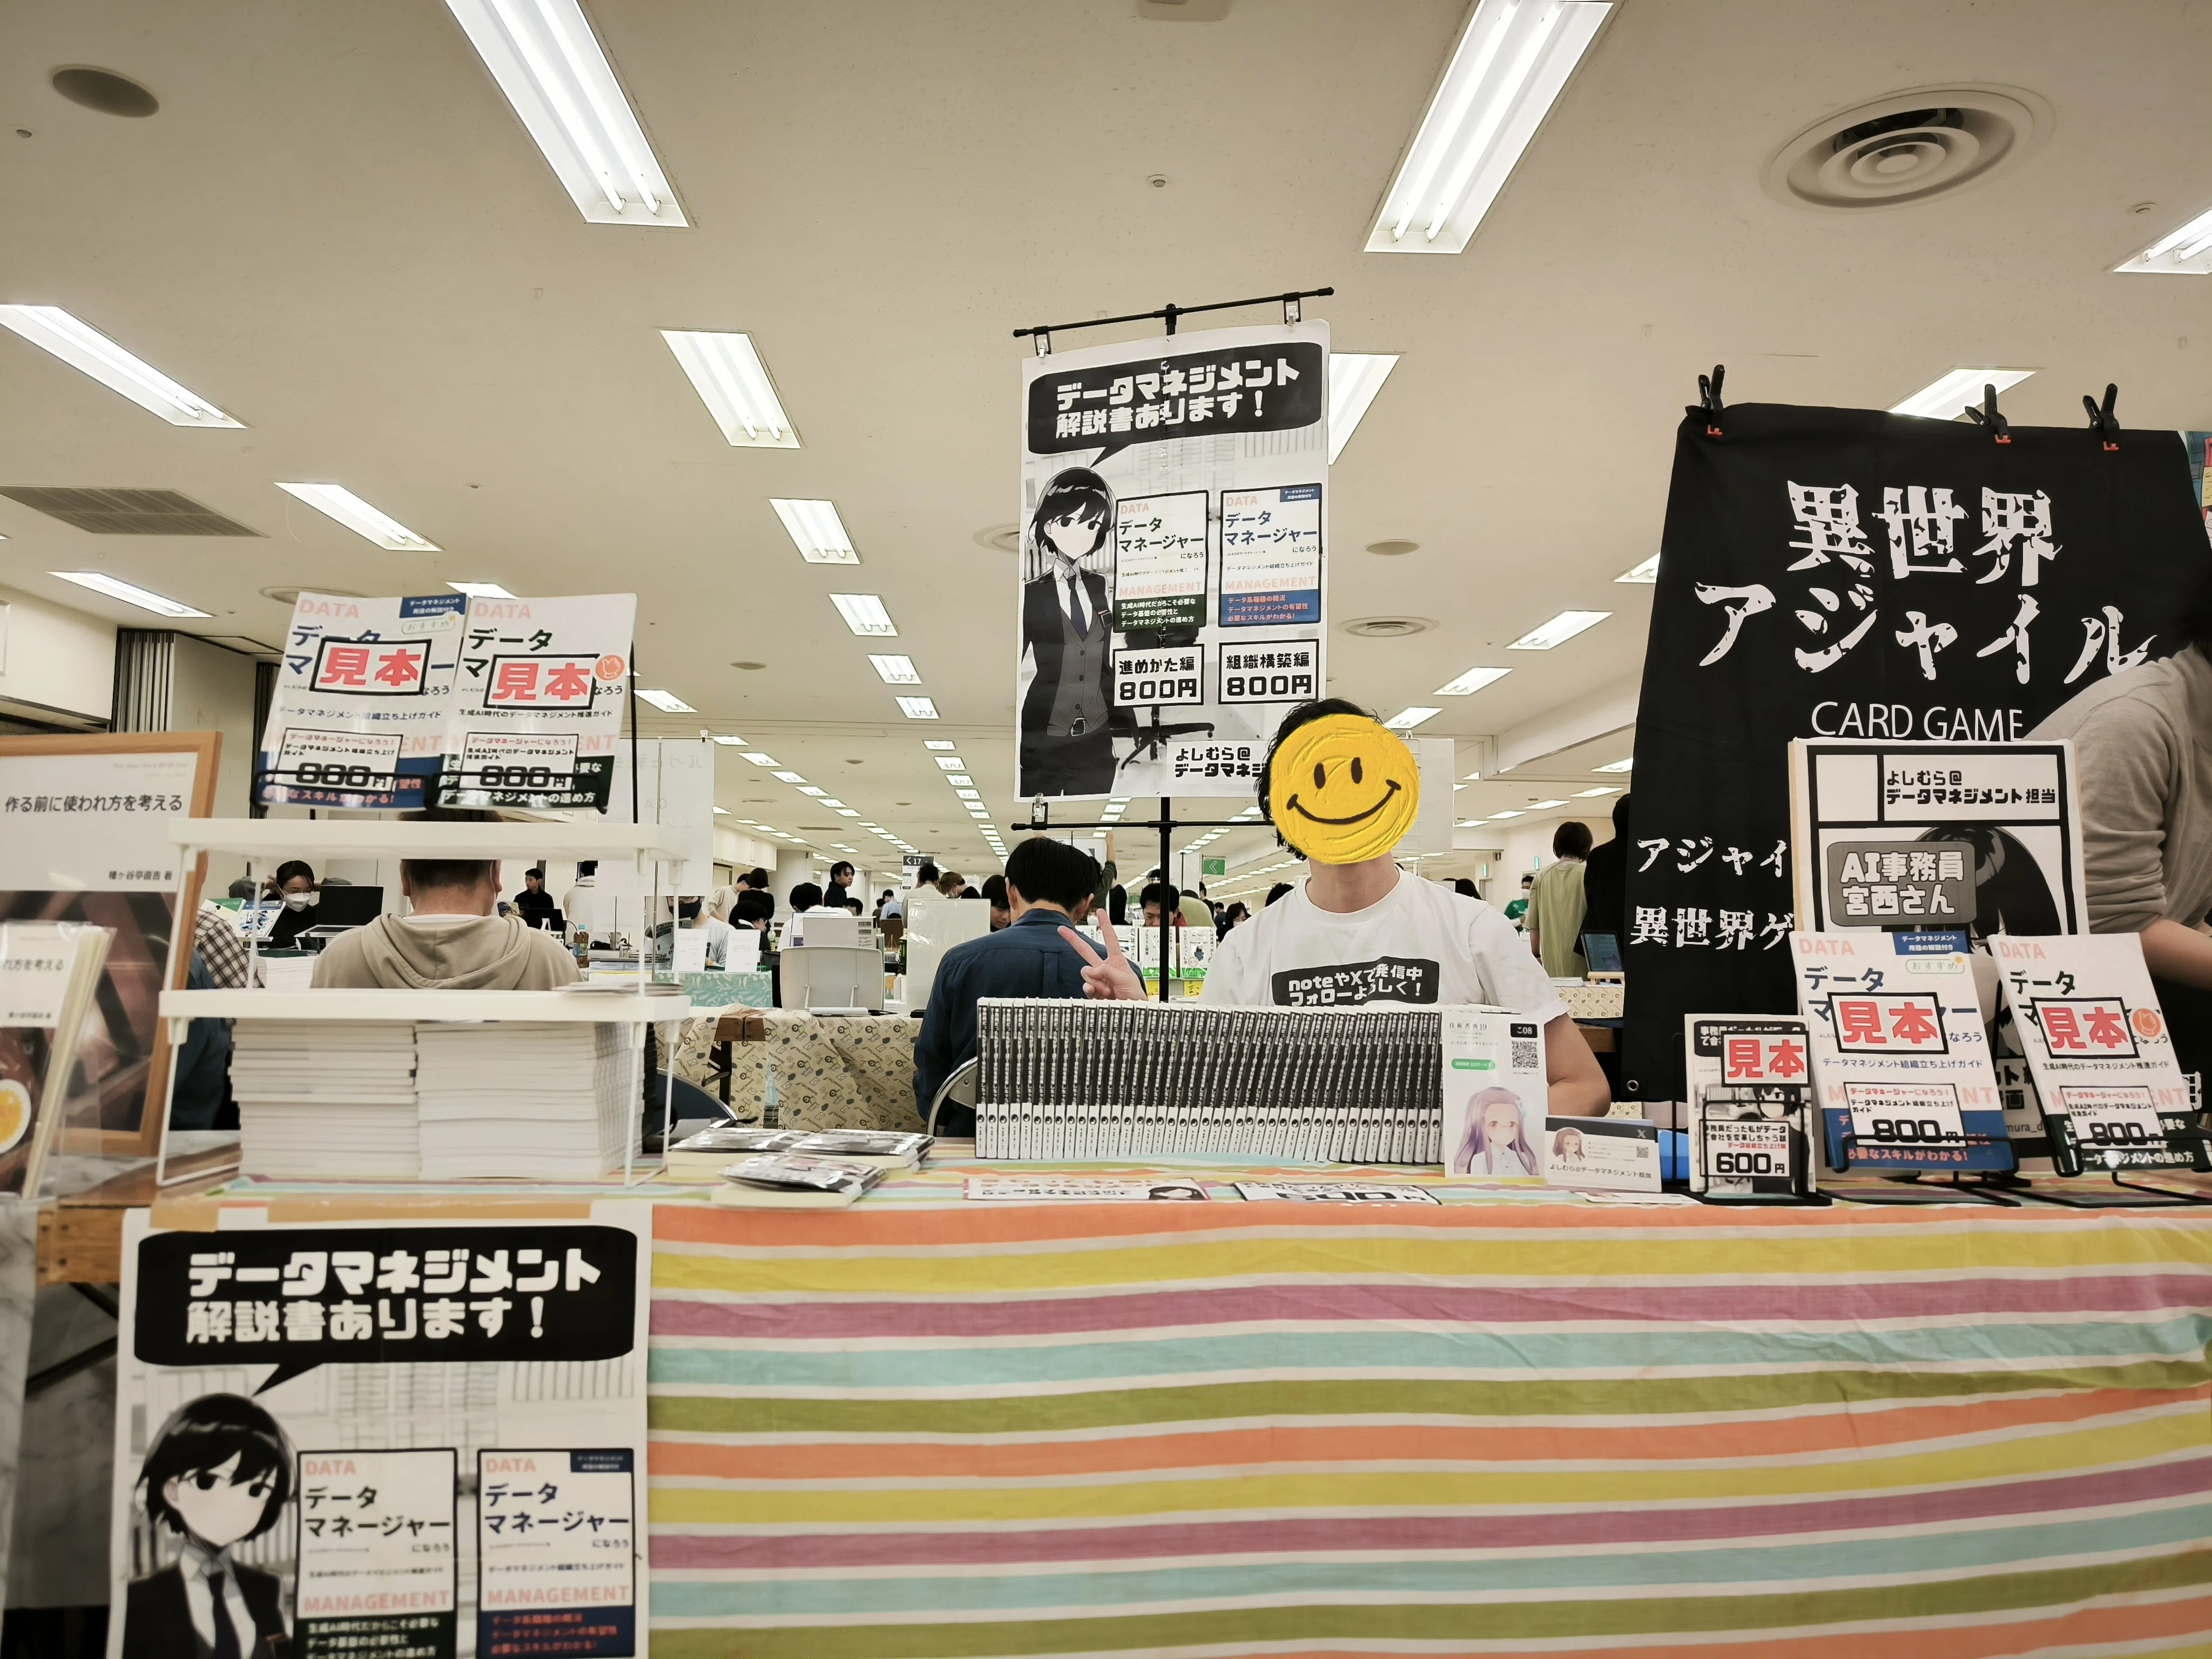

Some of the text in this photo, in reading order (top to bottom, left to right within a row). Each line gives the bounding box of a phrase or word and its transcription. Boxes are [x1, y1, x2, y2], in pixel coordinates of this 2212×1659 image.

[1057, 358, 1300, 412] データマネジメント
[1055, 390, 1264, 439] 解説書あります！
[1121, 503, 1149, 515] DATA
[1226, 495, 1258, 507] DATA
[1119, 517, 1162, 535] データ
[1225, 510, 1272, 528] データ
[1119, 534, 1204, 552] マネージャー
[1224, 528, 1317, 545] マネージャー
[1786, 480, 2063, 586] 異世界
[1119, 582, 1203, 597] MANAGEMENT
[1225, 576, 1316, 591] MANAGEMENT
[299, 599, 360, 618] DATA
[474, 602, 531, 619] DATA
[1121, 598, 1196, 609] 生成AI時代だからこそ必要な
[1121, 616, 1195, 628] データマネジメントの進め方
[468, 628, 552, 652] データ
[1695, 581, 2158, 684] アジャイル
[319, 647, 421, 687] 見本
[1118, 656, 1195, 675] 進めかた編
[1226, 652, 1310, 670] 組織構築編
[491, 662, 591, 701] 見本
[1120, 678, 1197, 700] 800円
[1227, 674, 1312, 696] 800円
[1810, 700, 2024, 742] CARD GAME
[1176, 746, 1251, 761] よしむら@
[1886, 770, 1963, 786] よしむら@
[5, 794, 183, 813] 作る前に使われ方を考える
[1886, 787, 2056, 806] データマネジメント担当
[1840, 851, 1965, 884] AI事務員
[1842, 884, 1956, 918] 宮西さん
[1799, 938, 1855, 956] DATA
[1901, 934, 1957, 943] データマネジメント
[1998, 941, 2046, 960] DATA
[1912, 961, 1958, 972] おすすめ
[1289, 963, 1422, 992] noteやXで発信中
[1804, 965, 1884, 992] データ
[2009, 970, 2076, 995] データ
[1838, 1001, 1939, 1044] 見本
[2041, 1006, 2129, 1049] 見本
[1727, 1038, 1805, 1078] 見本
[1823, 1057, 1983, 1069] データマネジメント組織立ち上げガイド
[2043, 1060, 2169, 1070] 生成AI時代のデータマネジメント推進ガイド
[1716, 1152, 1785, 1174] 600円
[188, 1248, 601, 1297] データマネジメント
[186, 1296, 544, 1344] 解説書あります！
[305, 1460, 356, 1476] DATA
[486, 1458, 536, 1473] DATA
[305, 1486, 377, 1509] データ
[485, 1482, 558, 1507] データ
[305, 1515, 450, 1537] マネージャー
[485, 1510, 629, 1534] マネージャー
[304, 1591, 450, 1612] MANAGEMENT
[488, 1586, 630, 1606] MANAGEMENT
